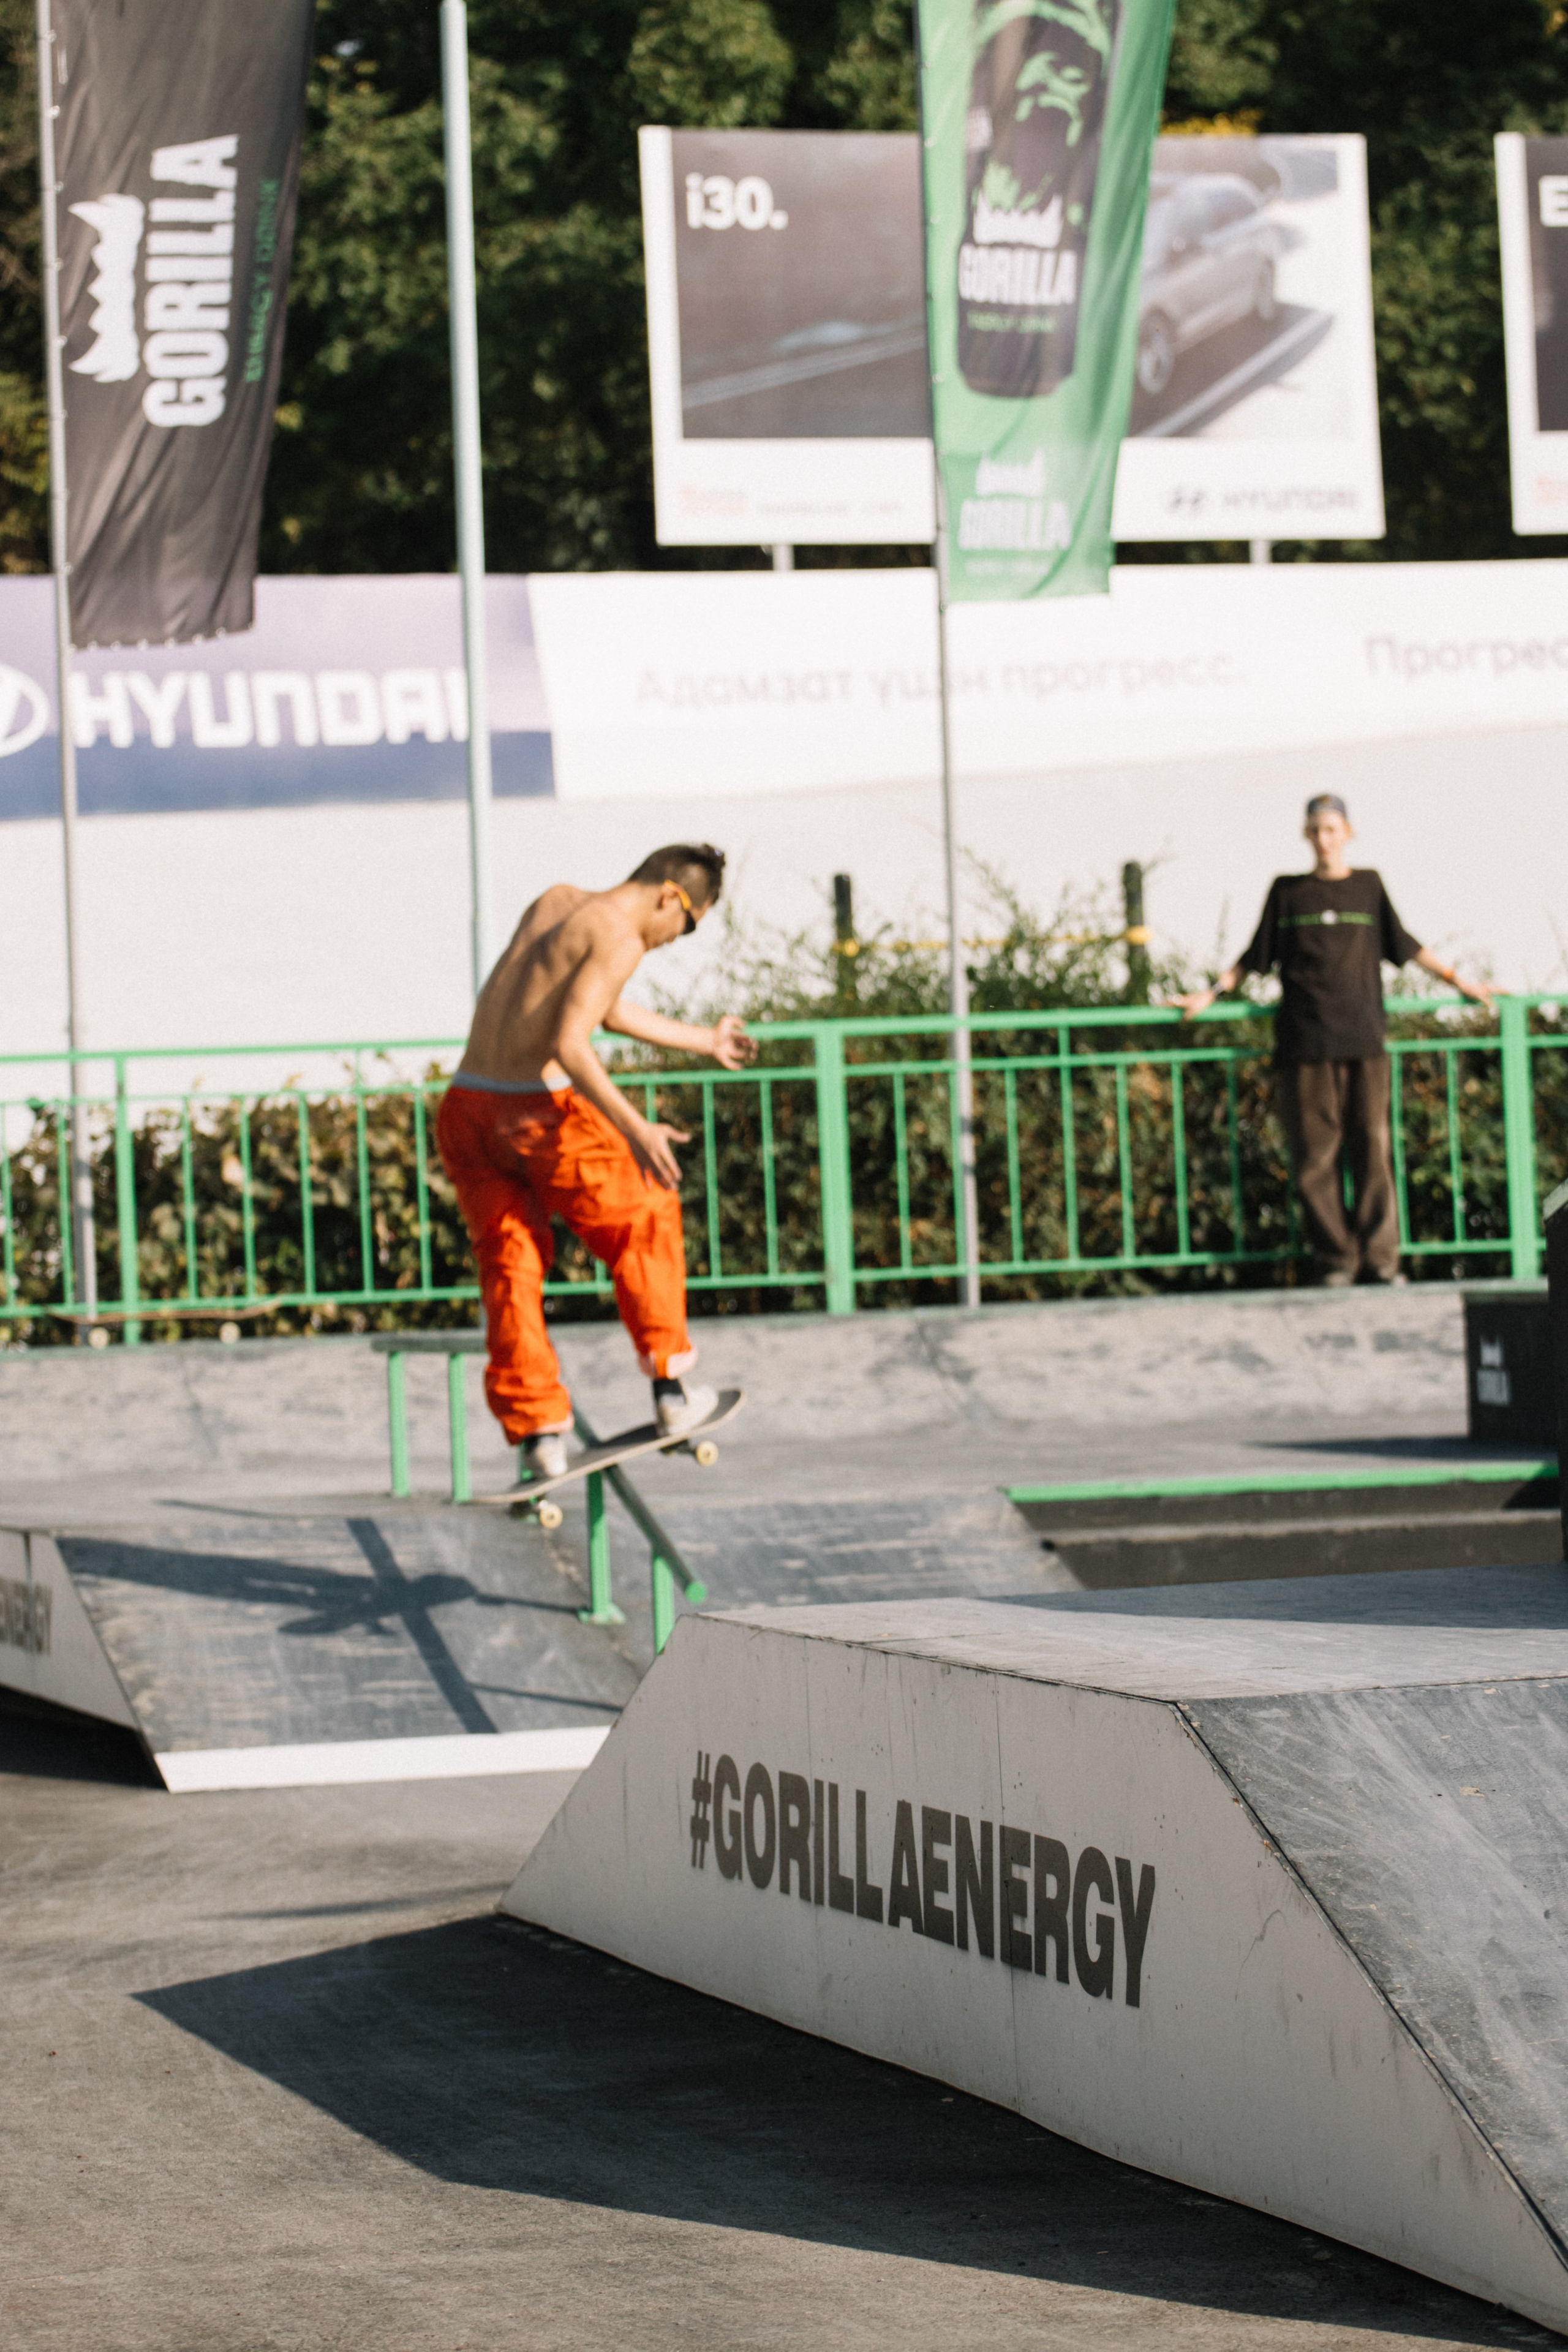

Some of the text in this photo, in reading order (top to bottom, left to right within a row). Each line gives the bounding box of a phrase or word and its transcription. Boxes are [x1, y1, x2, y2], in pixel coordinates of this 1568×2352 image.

[685, 172, 789, 230] i30.
[143, 134, 239, 428] GORILLA
[69, 669, 469, 748] HYUNDAI
[637, 668, 853, 710] Адамзат
[867, 665, 990, 710] үшн
[690, 1750, 1156, 2008] #GORILLAENERGY
